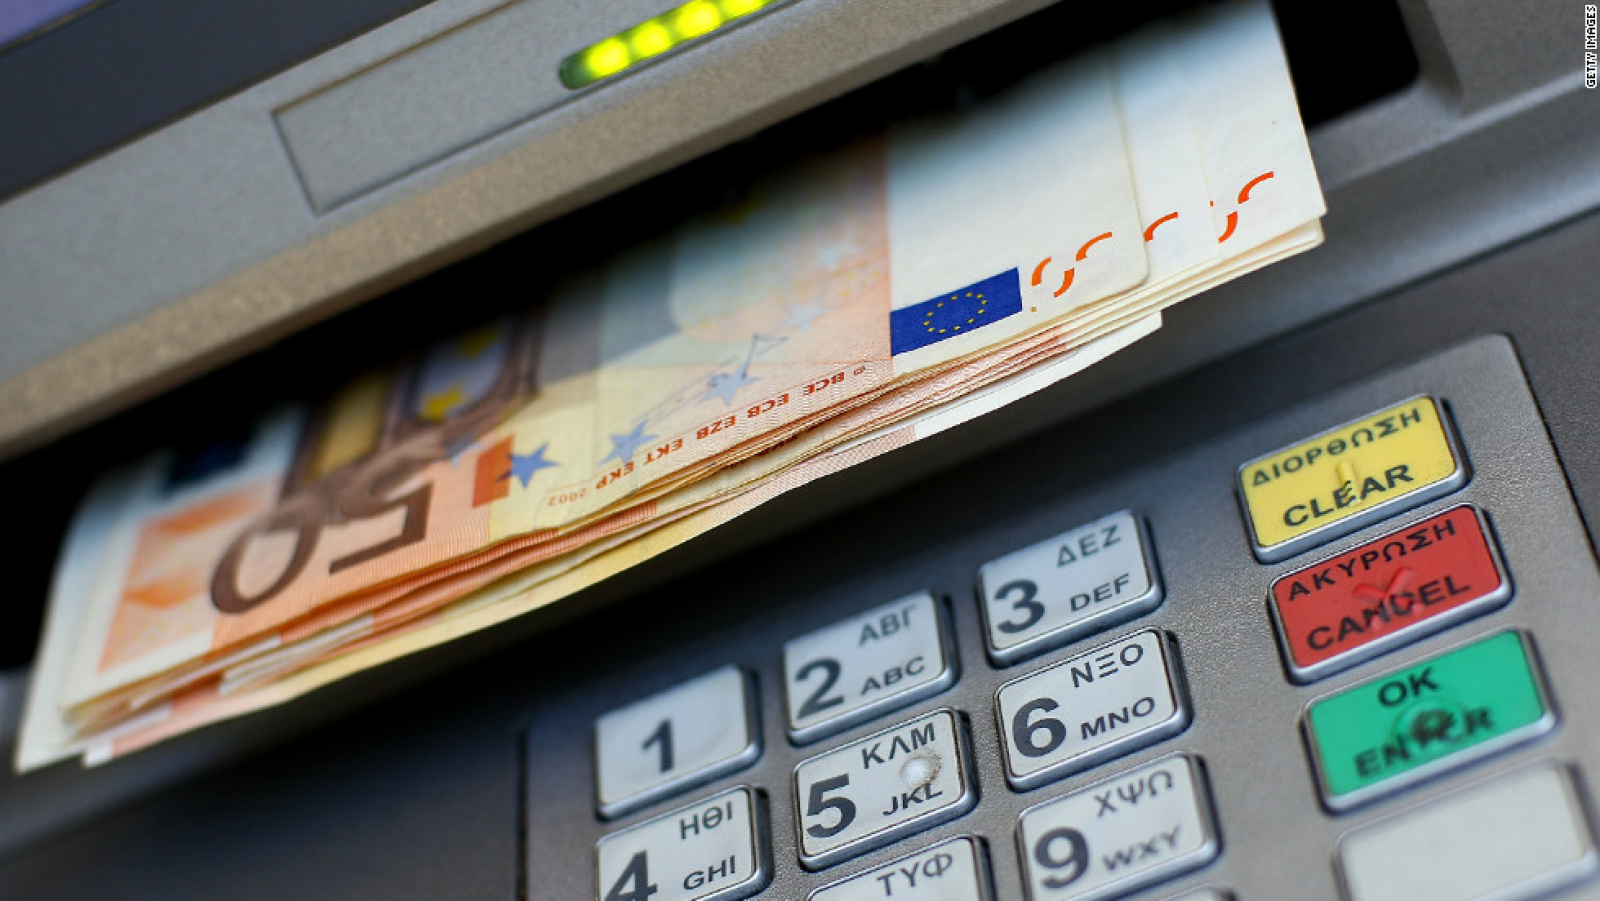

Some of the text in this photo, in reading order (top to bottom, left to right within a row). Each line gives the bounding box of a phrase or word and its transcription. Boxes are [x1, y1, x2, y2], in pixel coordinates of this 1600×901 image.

[747, 392, 790, 419] ECB
[802, 371, 845, 397] BCE
[643, 438, 684, 466] EKT
[696, 415, 736, 440] EZB
[1252, 407, 1422, 487] ΔΙΟΡΘΩΣΗ
[548, 487, 588, 507] 2002
[595, 461, 635, 490] EKP
[1284, 463, 1413, 529] CLEAR
[210, 458, 435, 615] 50
[1056, 524, 1122, 568] ΔΕΖ
[1288, 518, 1457, 602] ΑΚΥΡΩΣΗ
[993, 573, 1131, 634] 3 DEF
[1306, 575, 1471, 652] CANCEL
[794, 655, 926, 721] 2 ABC
[1378, 666, 1439, 708] OK
[641, 718, 674, 773] 1
[861, 722, 936, 769] ΚΛΜ
[1011, 696, 1156, 758] 6 MNO
[1354, 706, 1494, 779] ENR
[806, 773, 943, 838] 5 JKL
[1093, 770, 1173, 818] ΧΨΩ
[605, 850, 737, 901] 4 GHI
[1034, 824, 1181, 889] 9 WXY
